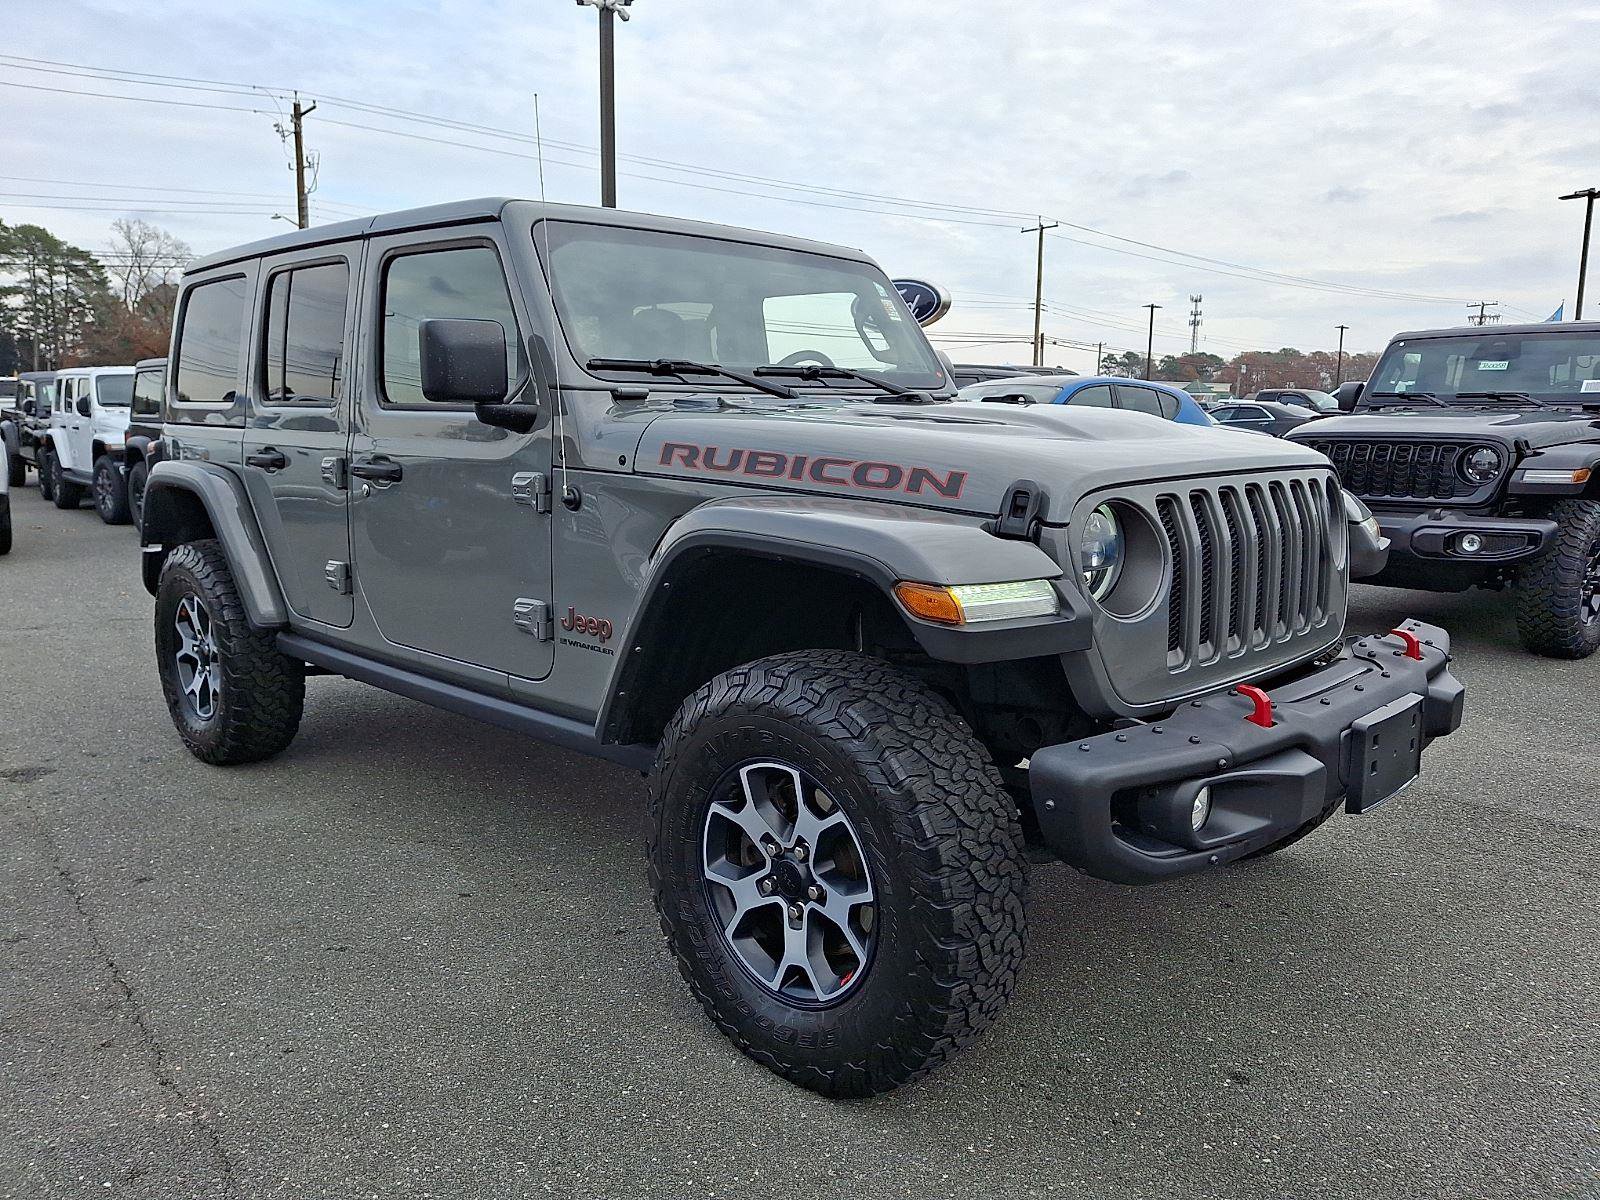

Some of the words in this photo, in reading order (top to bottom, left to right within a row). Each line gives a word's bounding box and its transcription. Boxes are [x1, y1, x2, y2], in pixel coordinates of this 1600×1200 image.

[658, 441, 968, 499] RUBICON
[560, 605, 612, 643] Jeep
[567, 639, 615, 656] WRANGLER
